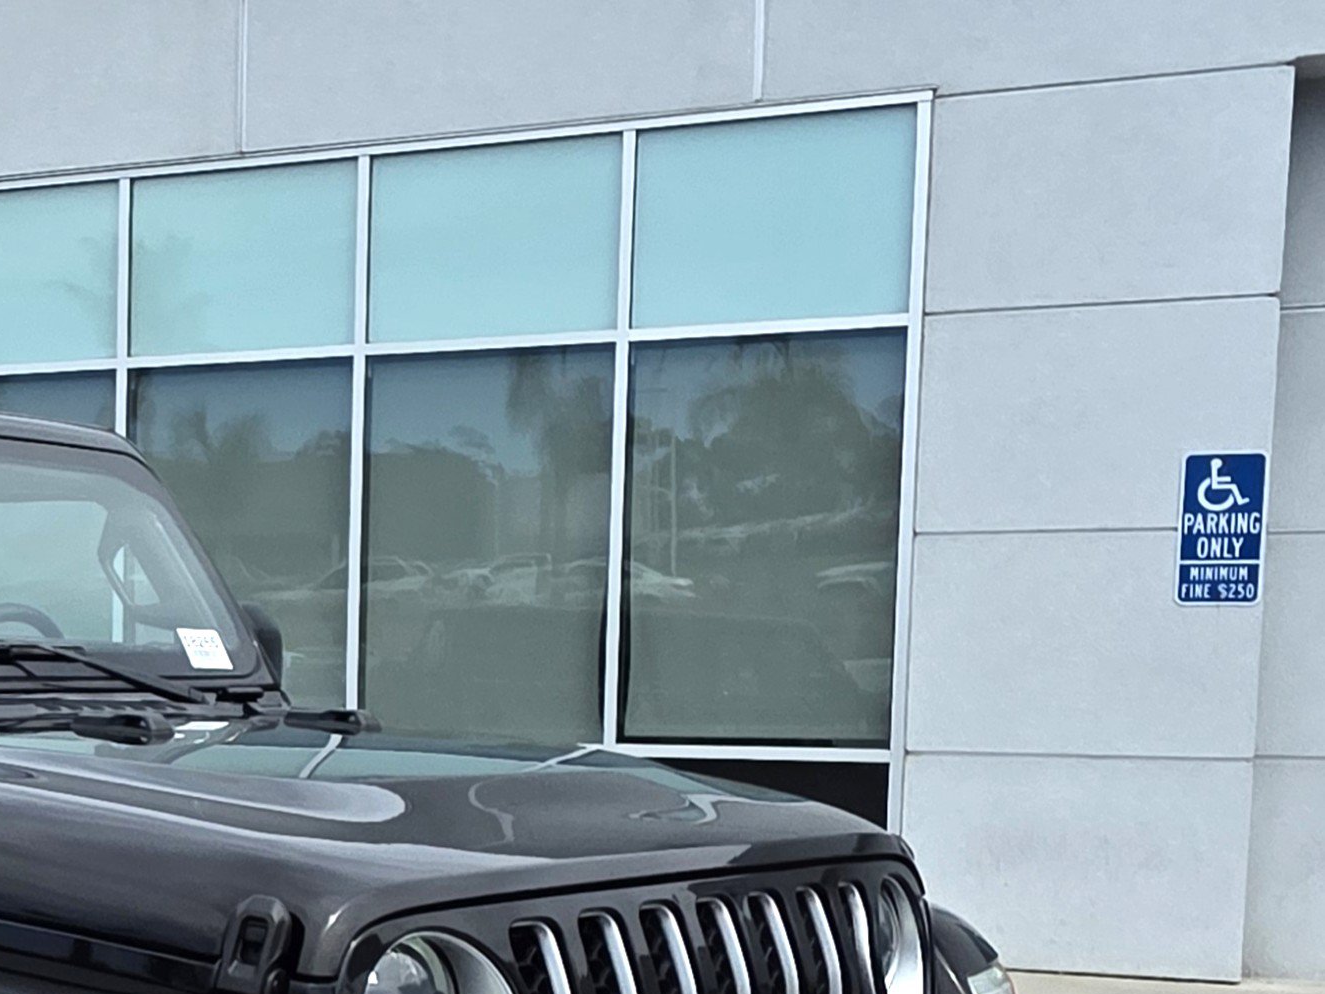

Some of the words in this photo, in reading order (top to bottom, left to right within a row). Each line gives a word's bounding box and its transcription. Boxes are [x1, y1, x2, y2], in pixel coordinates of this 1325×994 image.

[1183, 512, 1261, 535] PARKING
[1196, 536, 1244, 559] ONLY
[1189, 566, 1249, 581] MINIMUM
[1181, 583, 1212, 599] FINE
[1217, 583, 1255, 600] $250
